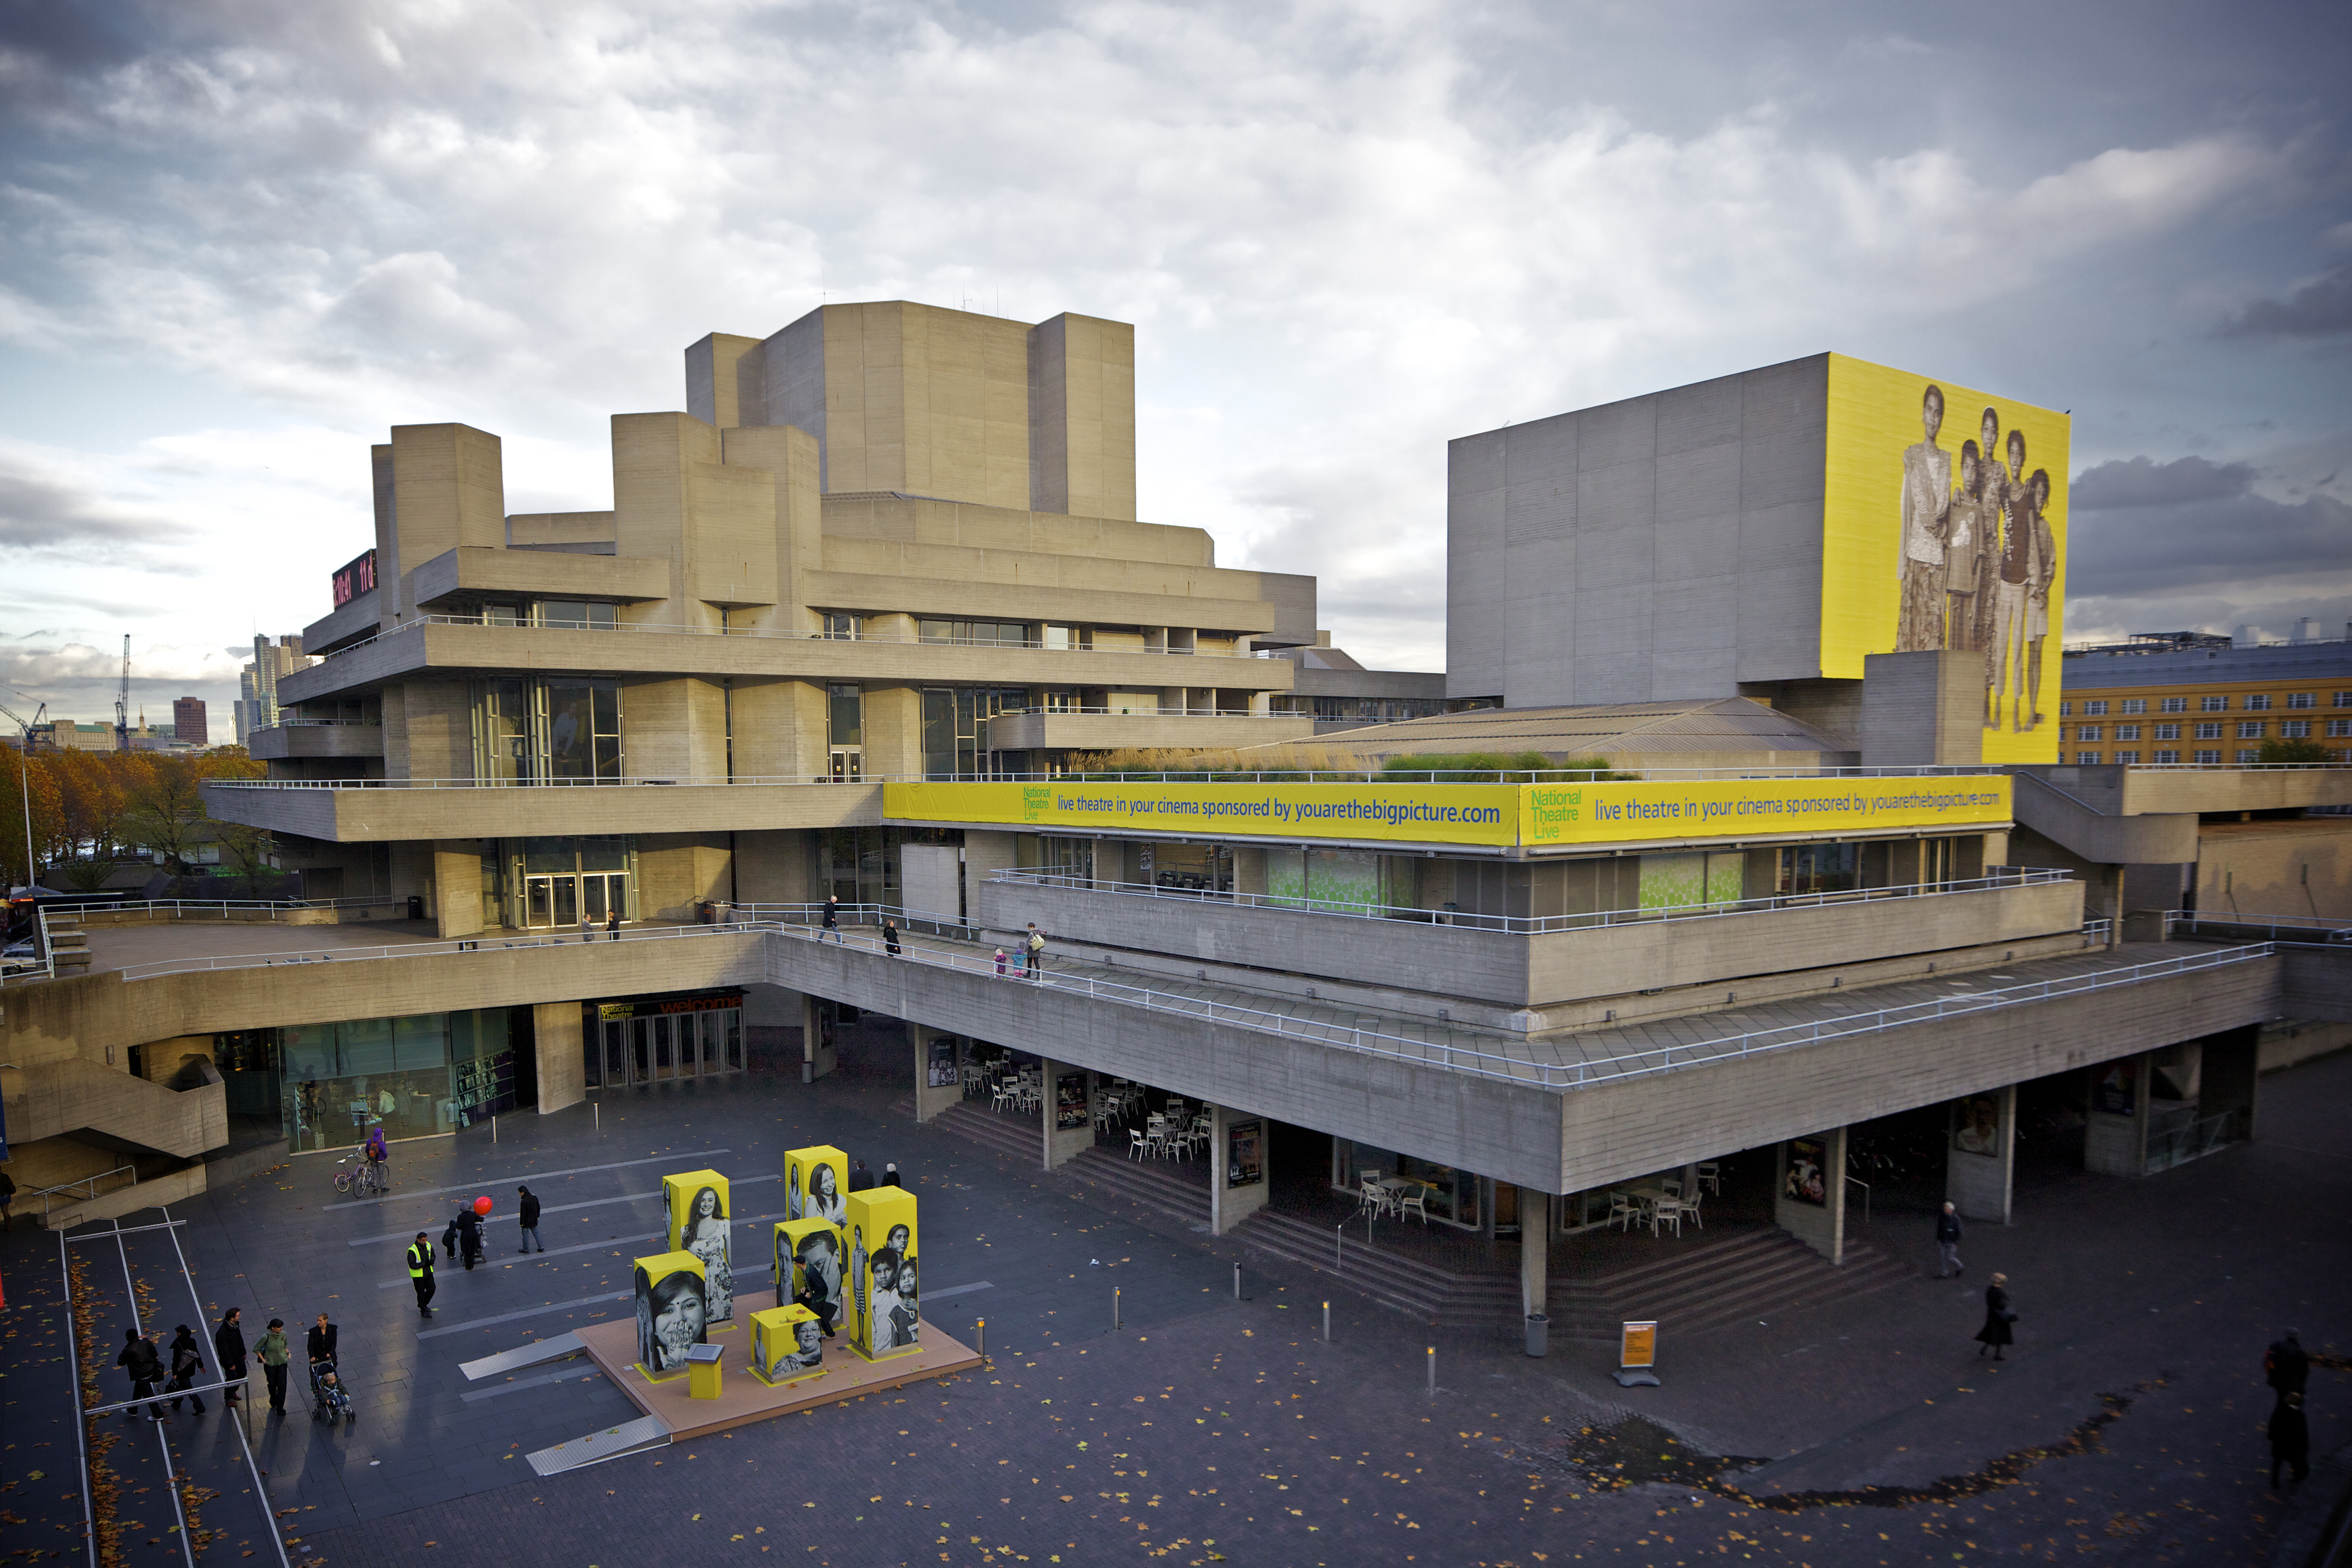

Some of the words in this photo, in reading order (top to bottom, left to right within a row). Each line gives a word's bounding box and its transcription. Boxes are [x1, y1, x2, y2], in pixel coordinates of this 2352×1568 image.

[1024, 787, 1051, 798] National
[1532, 789, 1581, 806] National
[1024, 797, 1049, 809] Theatre
[1057, 794, 1074, 811] live
[1076, 795, 1113, 812] theatre
[1117, 795, 1127, 812] in
[1129, 800, 1155, 817] your
[1158, 797, 1199, 815] cinema
[1202, 797, 1270, 819] sponsored
[1274, 798, 1291, 822] by
[1295, 799, 1500, 825] youarethebigpicture.com
[1596, 799, 1621, 820] live
[1626, 799, 1680, 819] theatre
[1684, 797, 1697, 817] in
[1702, 801, 1733, 822] your
[1736, 796, 1782, 815] cinema
[1786, 792, 1851, 818] sponsored
[1854, 792, 1868, 815] by
[1871, 790, 2000, 815] youarethebigpicture.com
[1024, 809, 1039, 820] Live
[1531, 806, 1578, 822] Theatre
[1534, 822, 1560, 839] Live
[601, 1005, 634, 1014] National
[660, 996, 743, 1014] welcome
